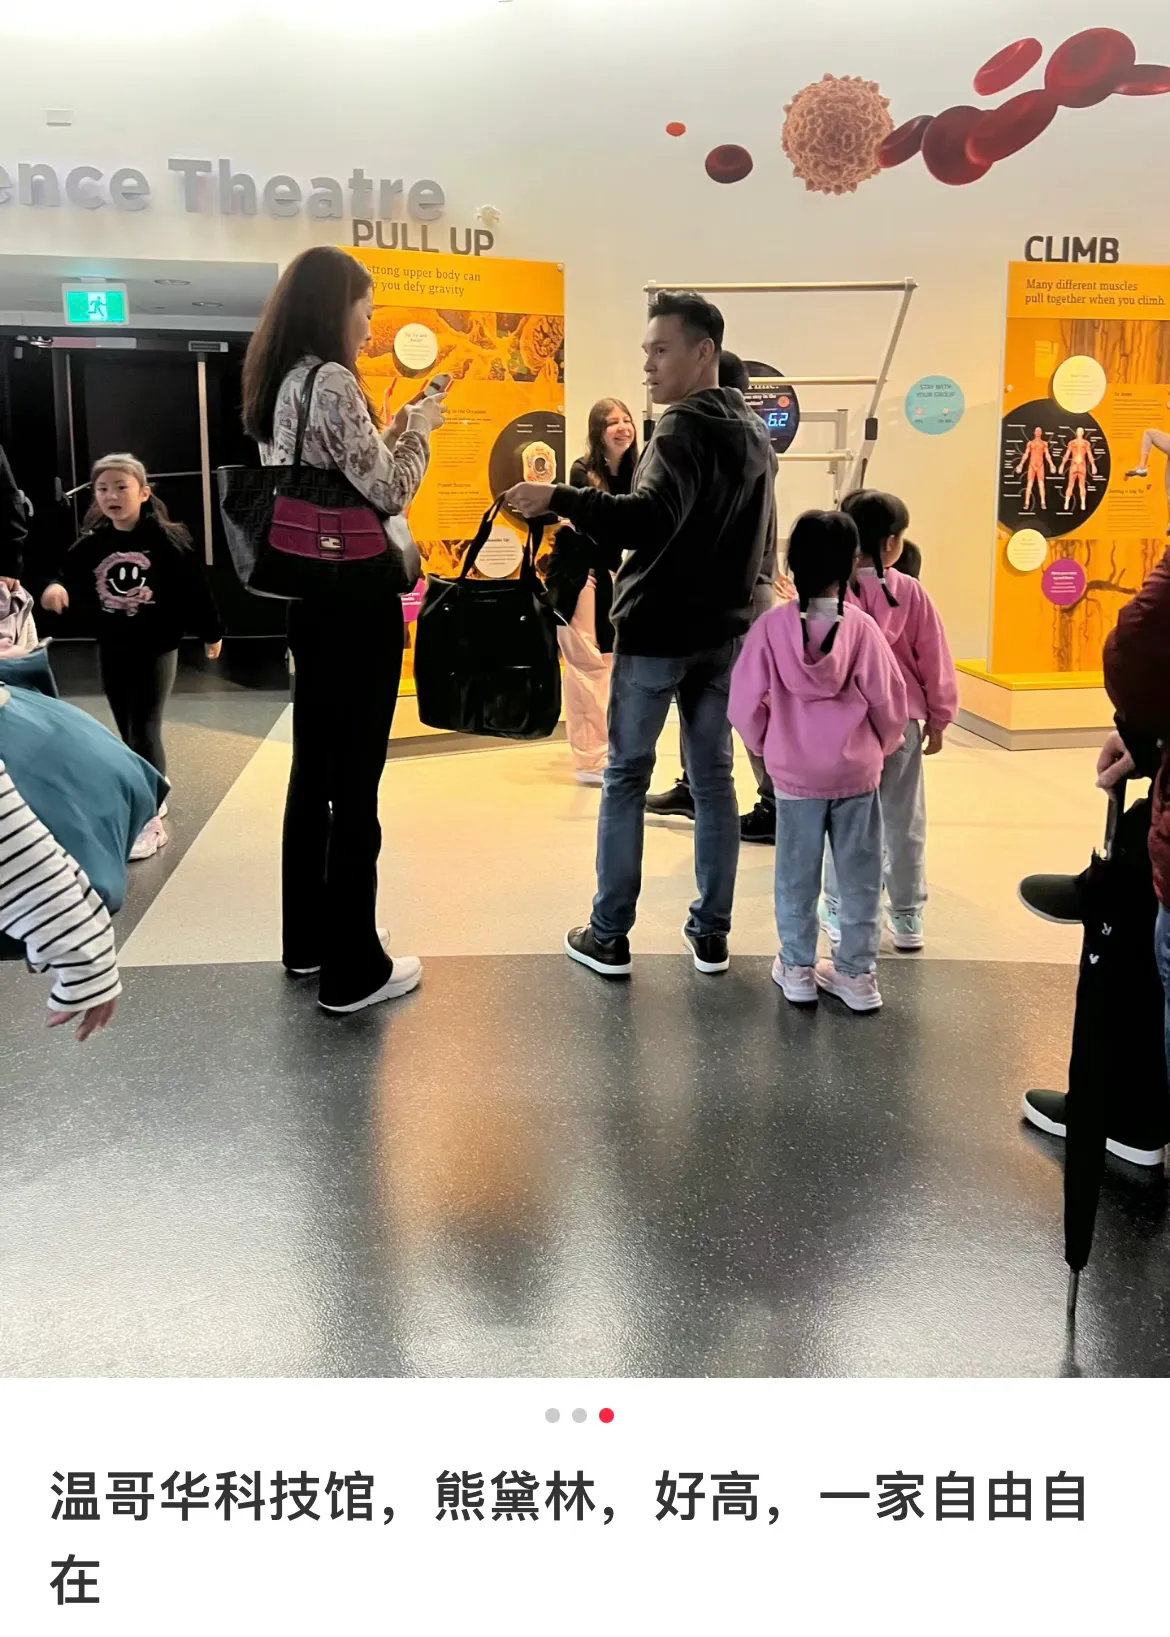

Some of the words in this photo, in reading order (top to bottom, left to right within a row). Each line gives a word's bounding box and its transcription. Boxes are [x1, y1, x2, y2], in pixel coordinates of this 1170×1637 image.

[168, 158, 446, 221] Theatre
[352, 218, 440, 254] PULL
[450, 226, 495, 257] UP
[1024, 234, 1120, 264] CLIMB
[366, 264, 400, 278] strong
[403, 268, 433, 279] upper
[436, 268, 460, 281] body
[463, 273, 481, 282] can
[381, 282, 400, 292] you
[403, 280, 426, 294] defy
[429, 284, 465, 297] gravity
[1026, 278, 1053, 291] Many
[1056, 279, 1096, 291] different
[1099, 281, 1138, 291] muscles
[1025, 293, 1044, 305] pull
[1047, 294, 1086, 306] together
[1089, 294, 1115, 305] when
[1118, 296, 1135, 307] you
[1138, 295, 1166, 306] climb.
[767, 412, 789, 427] 6.2
